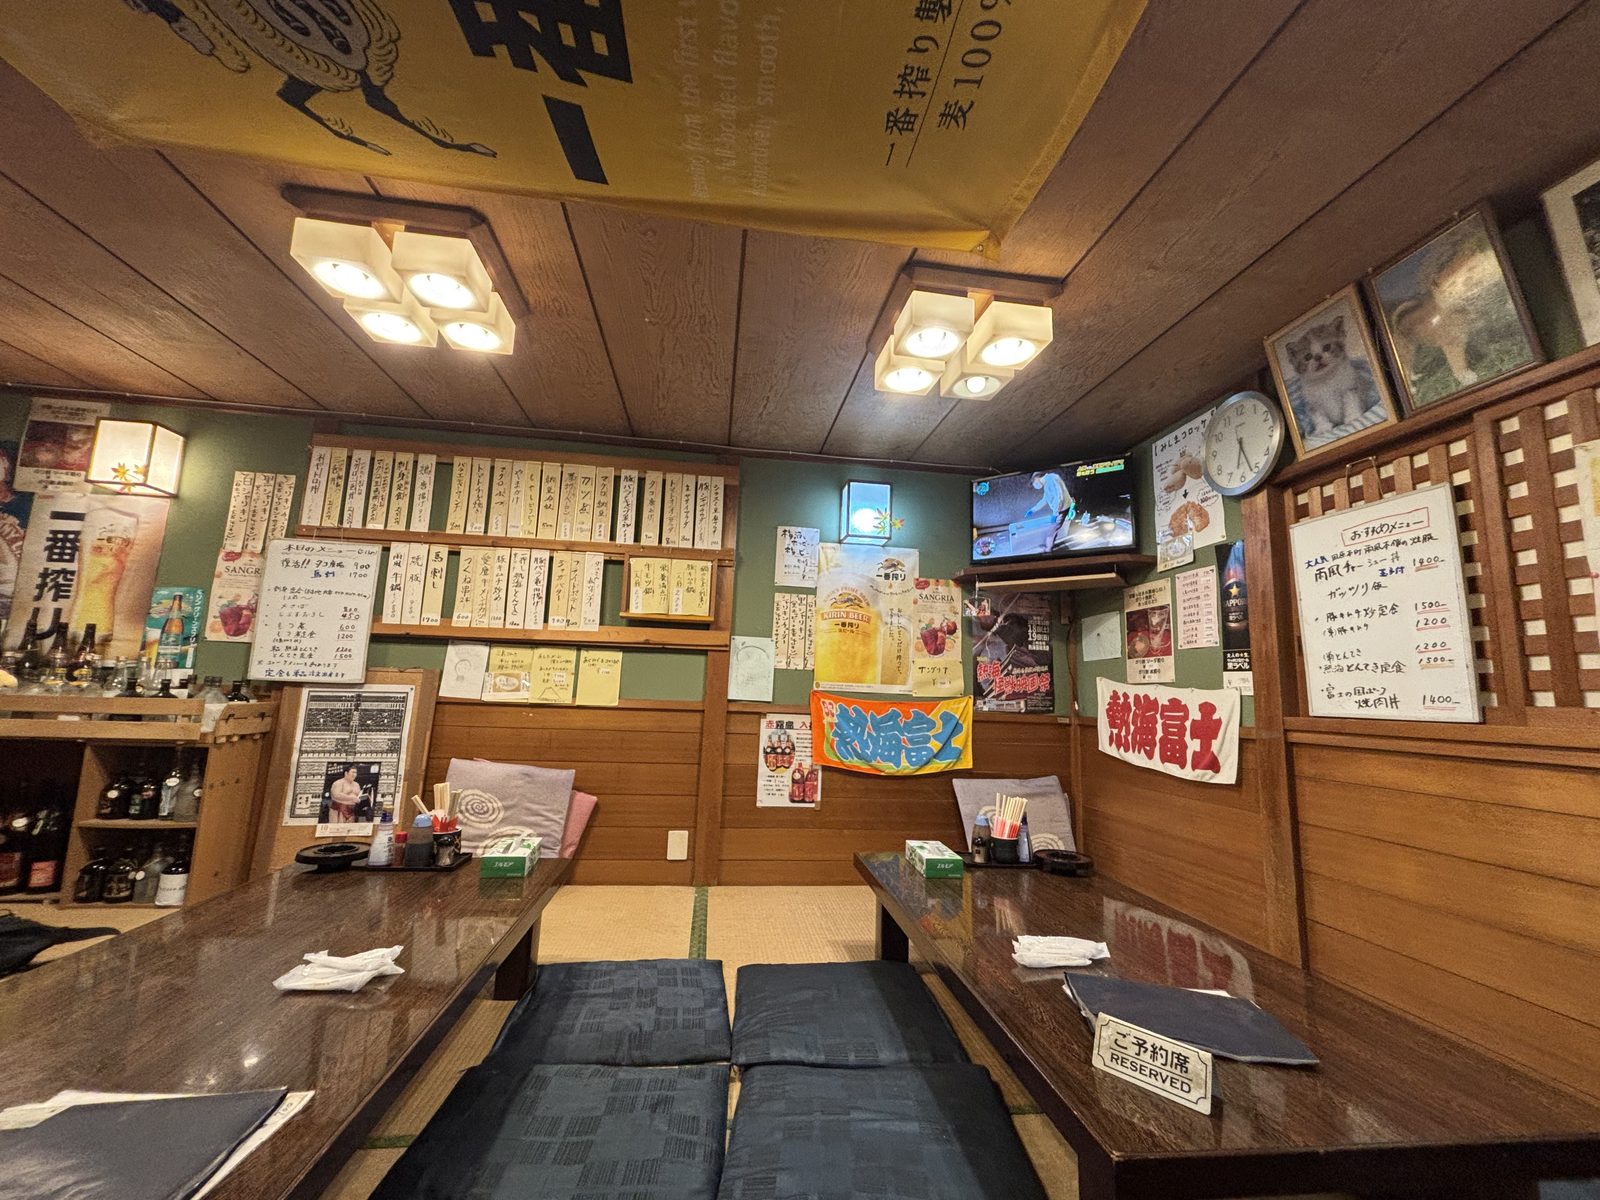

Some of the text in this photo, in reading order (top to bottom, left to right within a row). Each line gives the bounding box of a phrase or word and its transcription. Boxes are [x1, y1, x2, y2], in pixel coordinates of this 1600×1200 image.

[1235, 404, 1245, 416] 12
[1252, 404, 1257, 414] 1
[1223, 416, 1231, 427] 11
[1263, 411, 1272, 423] 2
[1214, 432, 1224, 443] 10
[1268, 426, 1274, 438] 3
[1212, 450, 1217, 460] 9
[1264, 446, 1270, 456] 4
[1217, 465, 1222, 475] 8
[1254, 462, 1260, 473] 5
[1227, 472, 1233, 483] 7
[1241, 472, 1246, 482] 6
[918, 593, 955, 602] SANGRIA
[823, 611, 870, 622] KIRIN BEER
[832, 703, 964, 769] 熱海富士
[1106, 690, 1223, 773] 熱海富士
[1112, 1030, 1190, 1074] ご予約席
[1110, 1054, 1193, 1094] RESERVED
